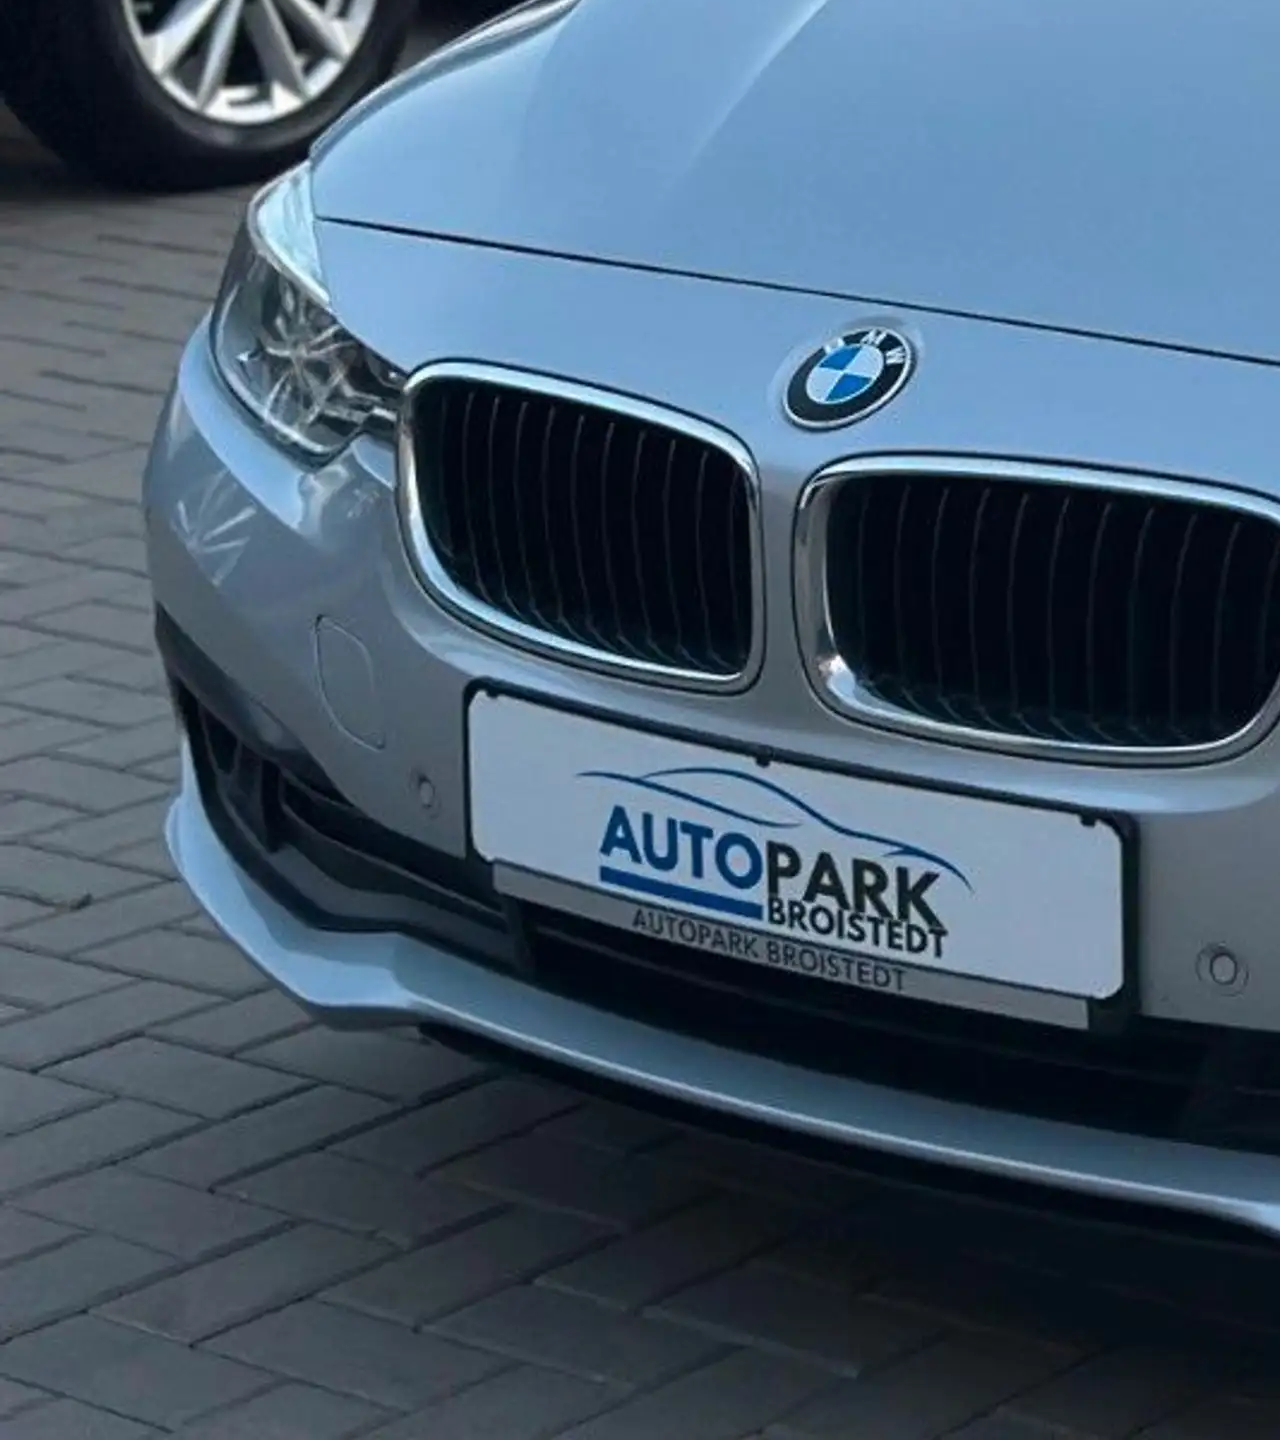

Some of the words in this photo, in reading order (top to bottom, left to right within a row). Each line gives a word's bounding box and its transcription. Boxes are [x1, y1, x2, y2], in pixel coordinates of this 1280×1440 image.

[600, 805, 948, 930] AUTOPARK
[632, 909, 758, 959] AUTOPARK
[766, 941, 907, 991] BROISTEDT
[767, 897, 948, 958] BROISTEDT
